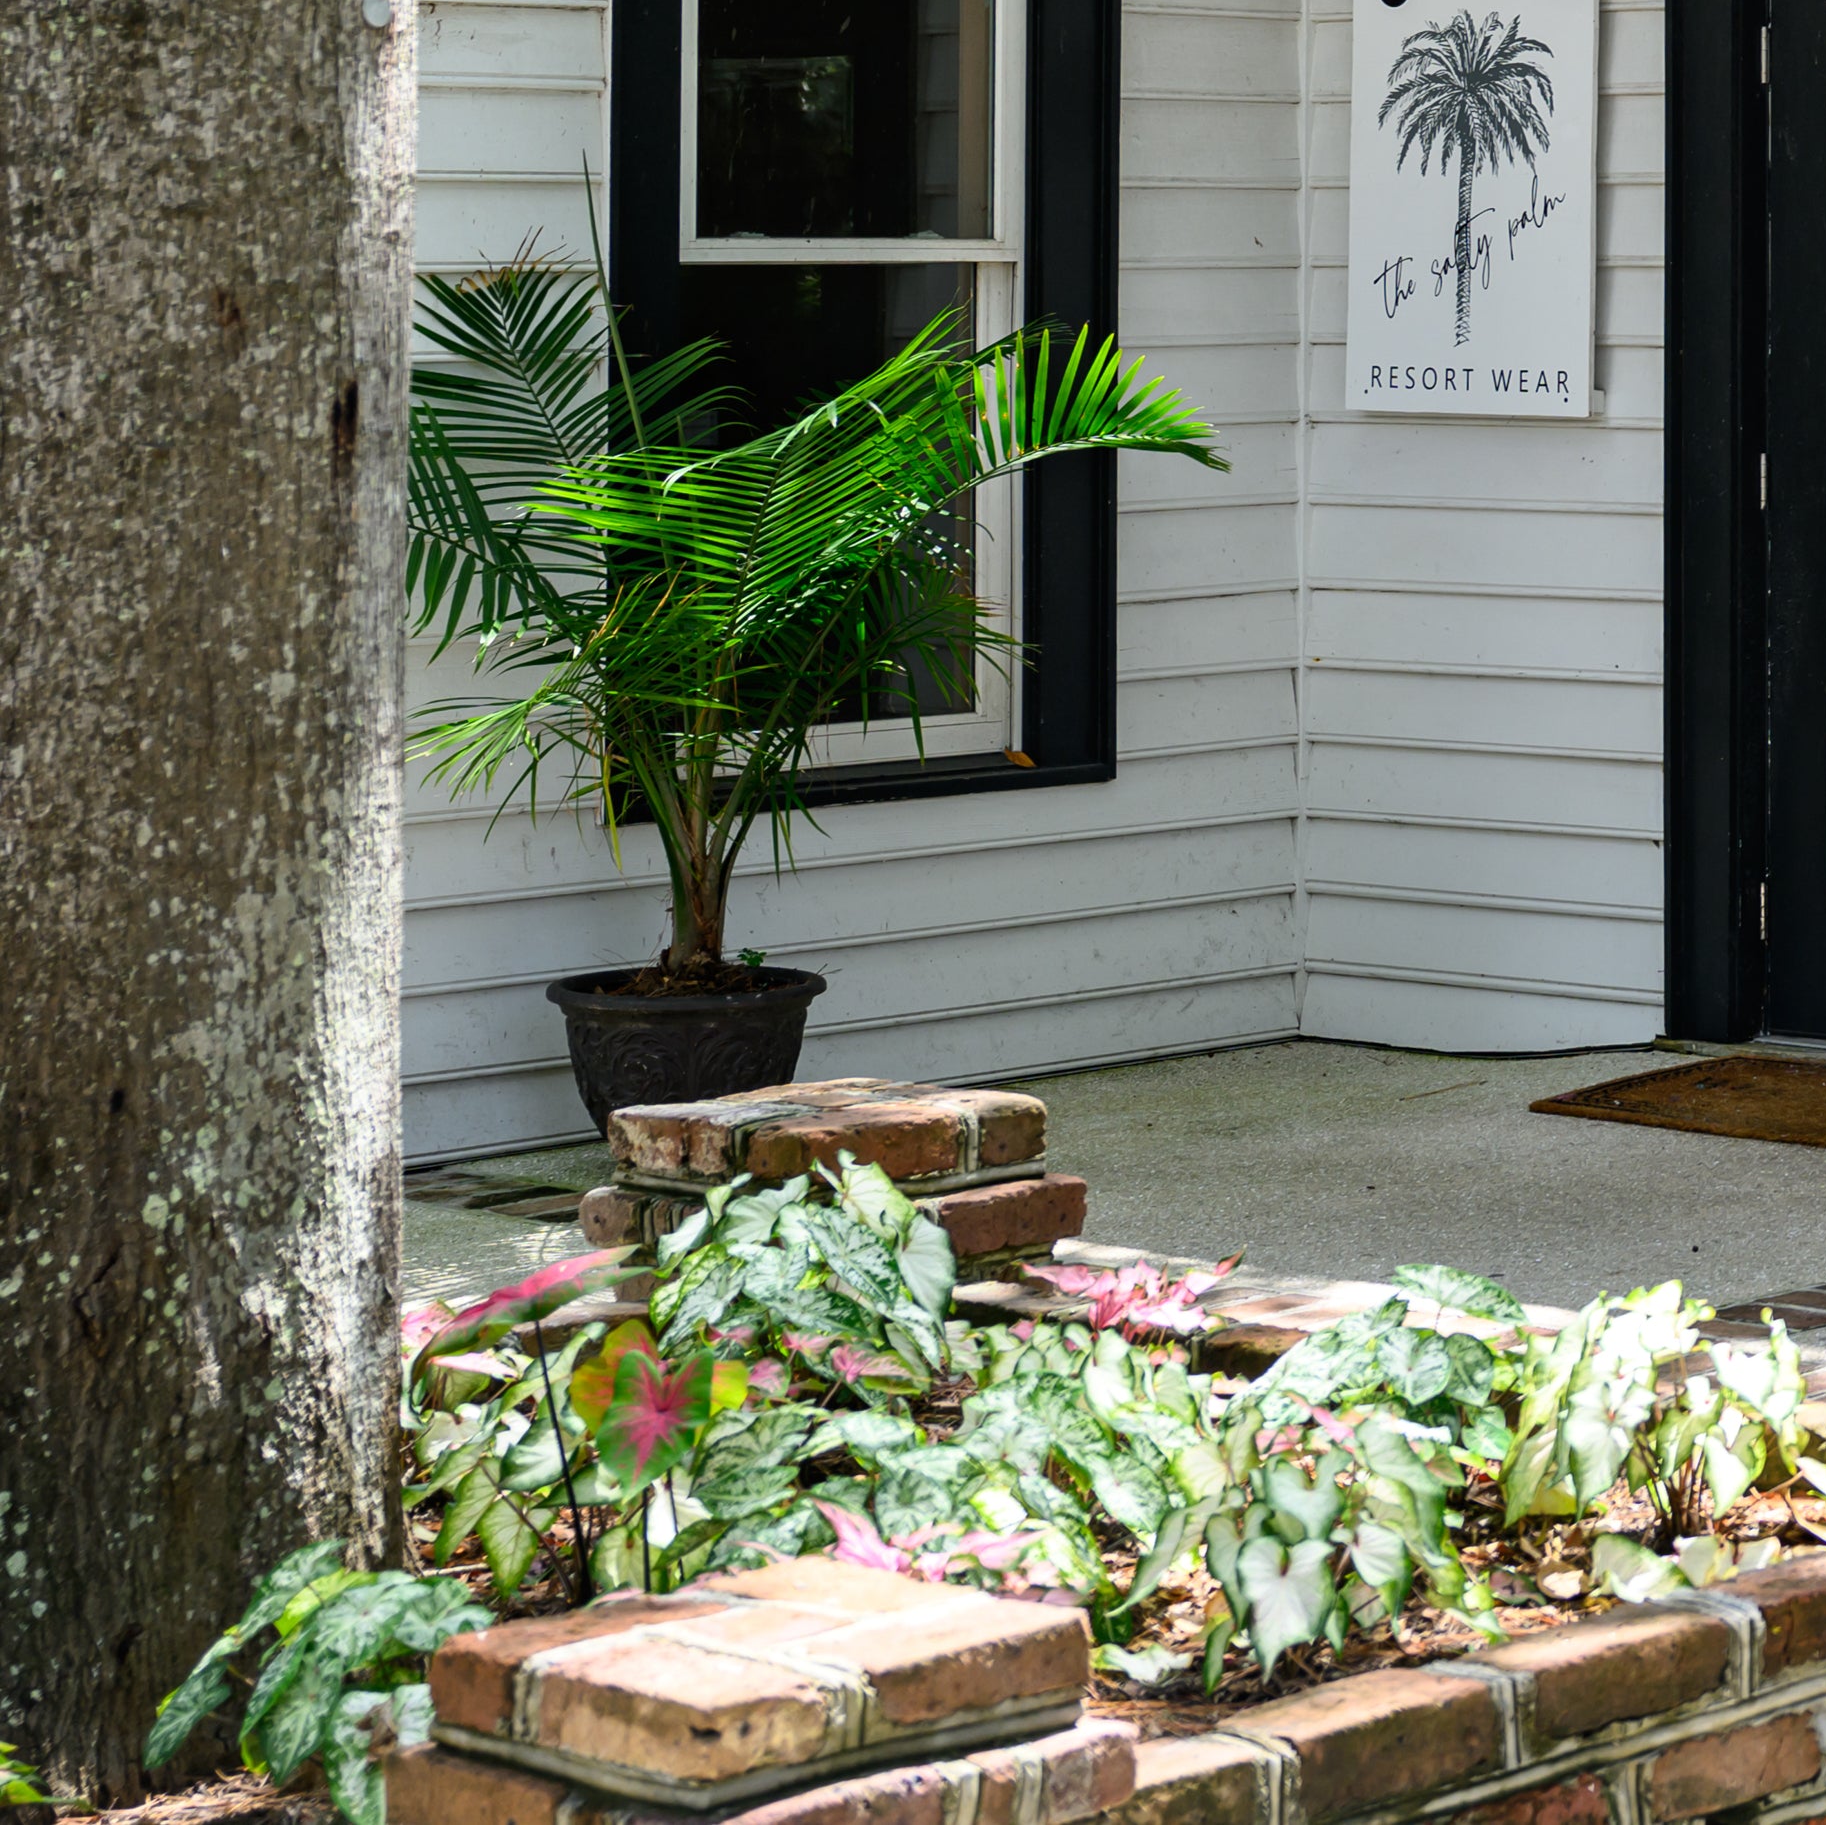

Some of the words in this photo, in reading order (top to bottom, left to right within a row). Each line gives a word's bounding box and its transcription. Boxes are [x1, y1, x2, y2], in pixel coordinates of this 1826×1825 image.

[1373, 256, 1417, 318] the
[1430, 207, 1496, 297] salty
[1507, 174, 1567, 261] palm
[1371, 365, 1474, 391] RESORT
[1491, 369, 1569, 394] WEAR
